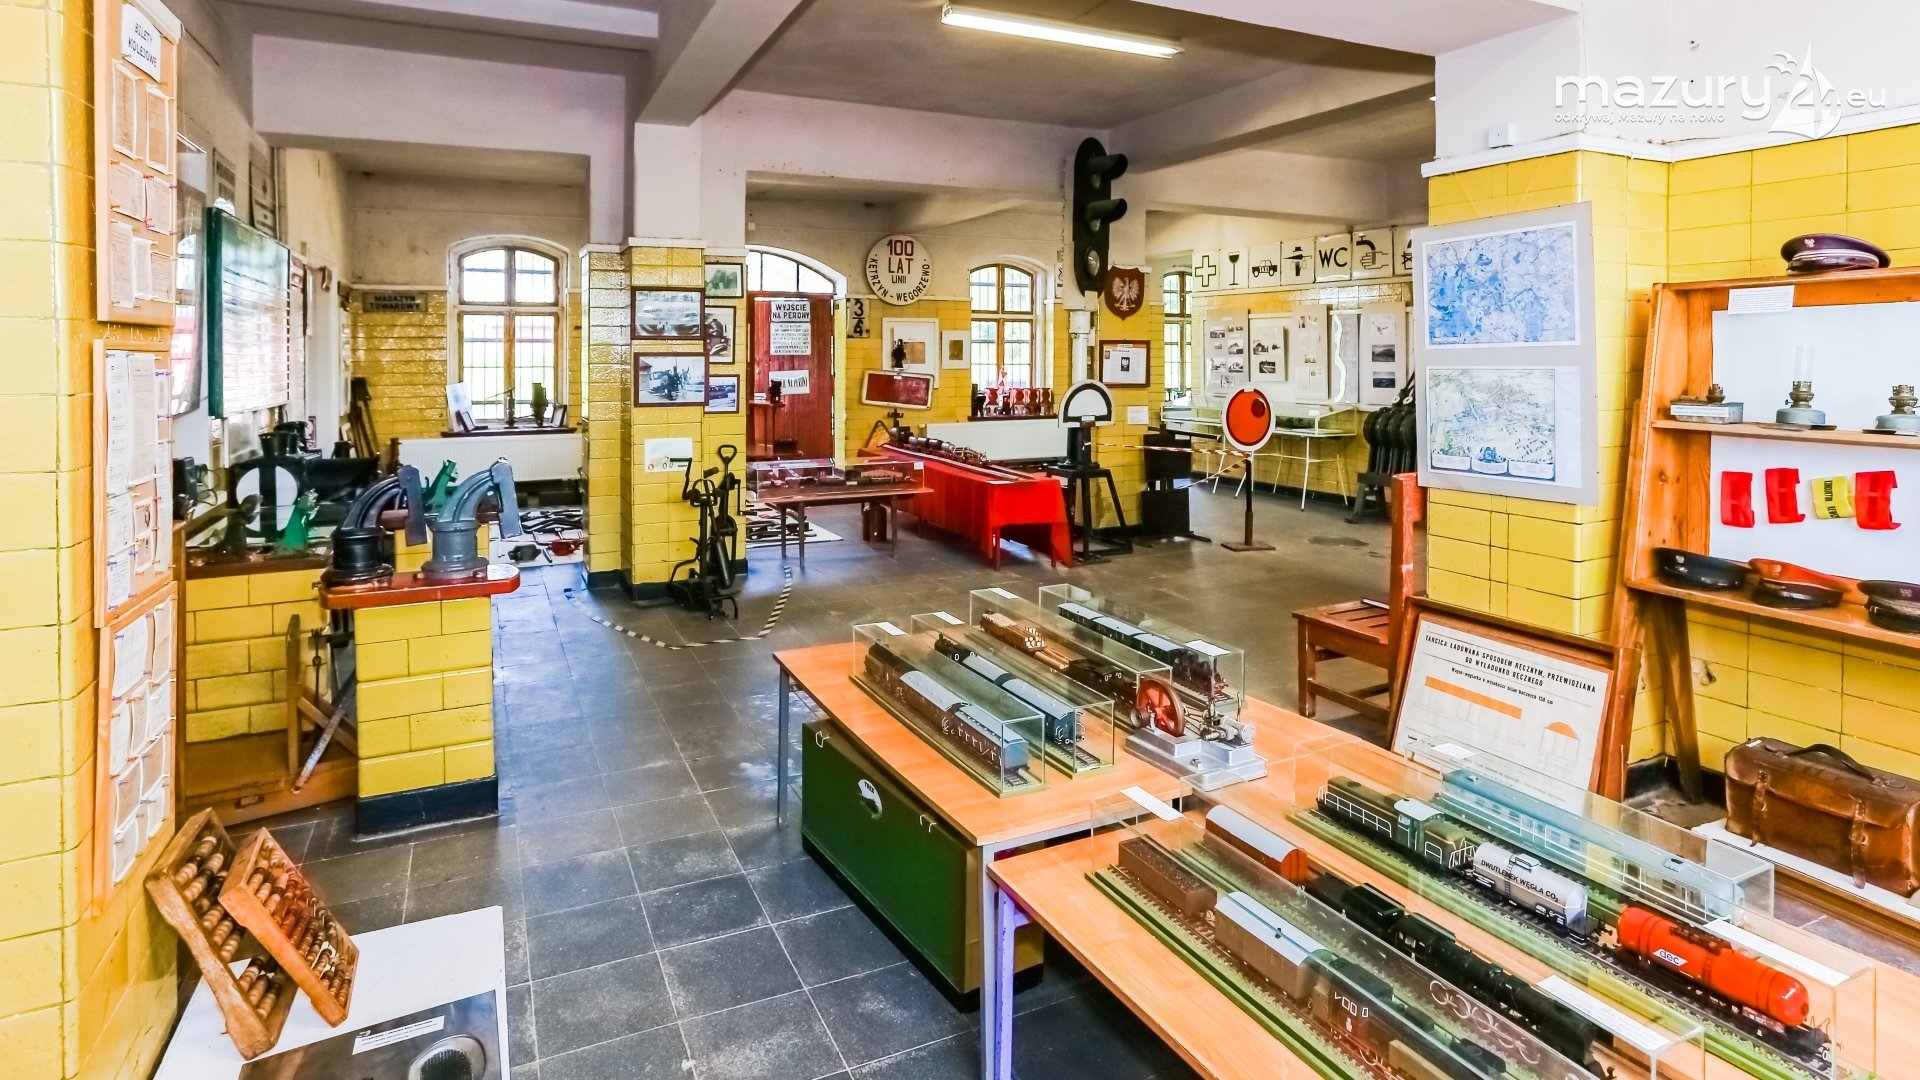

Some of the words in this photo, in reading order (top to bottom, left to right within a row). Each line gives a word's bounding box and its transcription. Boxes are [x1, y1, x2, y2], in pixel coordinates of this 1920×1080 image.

[134, 22, 152, 46] BILETY
[128, 37, 157, 68] KOLEJOWE
[886, 239, 914, 257] 100
[1318, 246, 1348, 268] WC
[888, 257, 914, 274] LAT
[868, 257, 889, 298] KĘTRZYN
[896, 264, 930, 303] WĘGORZEWO
[891, 275, 907, 284] LINII
[369, 302, 421, 310] TOWAROWY
[772, 311, 781, 319] NA
[783, 311, 810, 319] PERONY
[775, 302, 807, 311] WYJŚCIE
[854, 299, 864, 317] 3
[1425, 634, 1448, 647] TARCICA
[1449, 642, 1480, 657] ŁADOWANA
[1481, 652, 1513, 667] SPOSOBEM
[1547, 671, 1596, 693] PRZEWIDZIANA
[1512, 670, 1544, 687] RĘCZNEGO
[1481, 860, 1519, 882] DWUTLENEK
[1519, 878, 1544, 896] WĘGLA
[1660, 950, 1680, 965] dec
